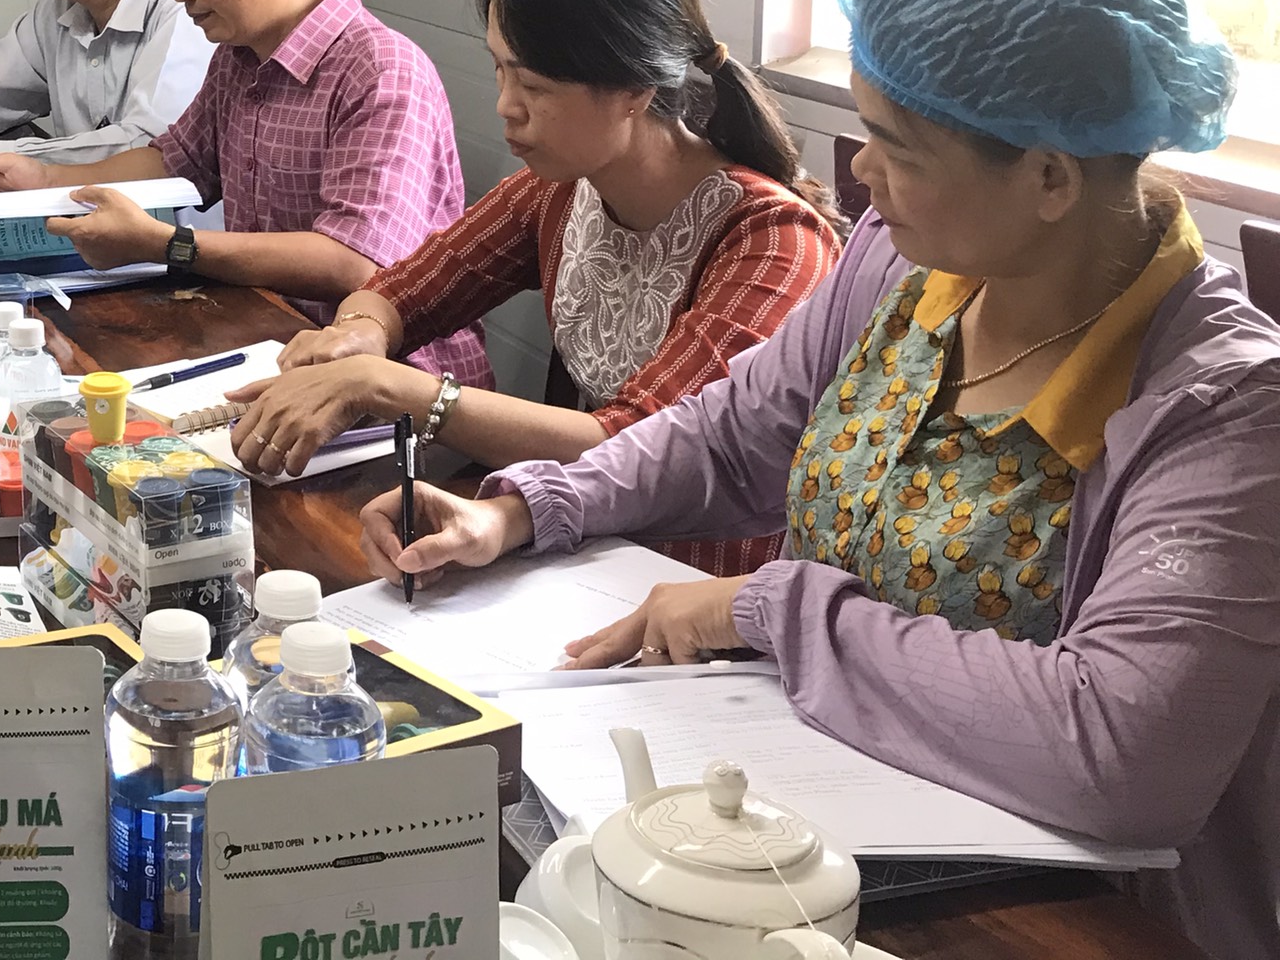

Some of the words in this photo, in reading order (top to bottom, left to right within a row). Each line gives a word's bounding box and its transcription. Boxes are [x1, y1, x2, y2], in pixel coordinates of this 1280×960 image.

[209, 520, 231, 532] BOX
[154, 548, 178, 560] Open
[222, 558, 246, 569] Open
[1154, 552, 1190, 575] 50
[17, 792, 62, 827] MÁ
[243, 844, 260, 853] PULL
[261, 842, 274, 851] TAB
[274, 840, 284, 849] TO
[285, 838, 305, 848] OPEN
[341, 918, 400, 958] CẦN
[408, 912, 464, 948] TÂY
